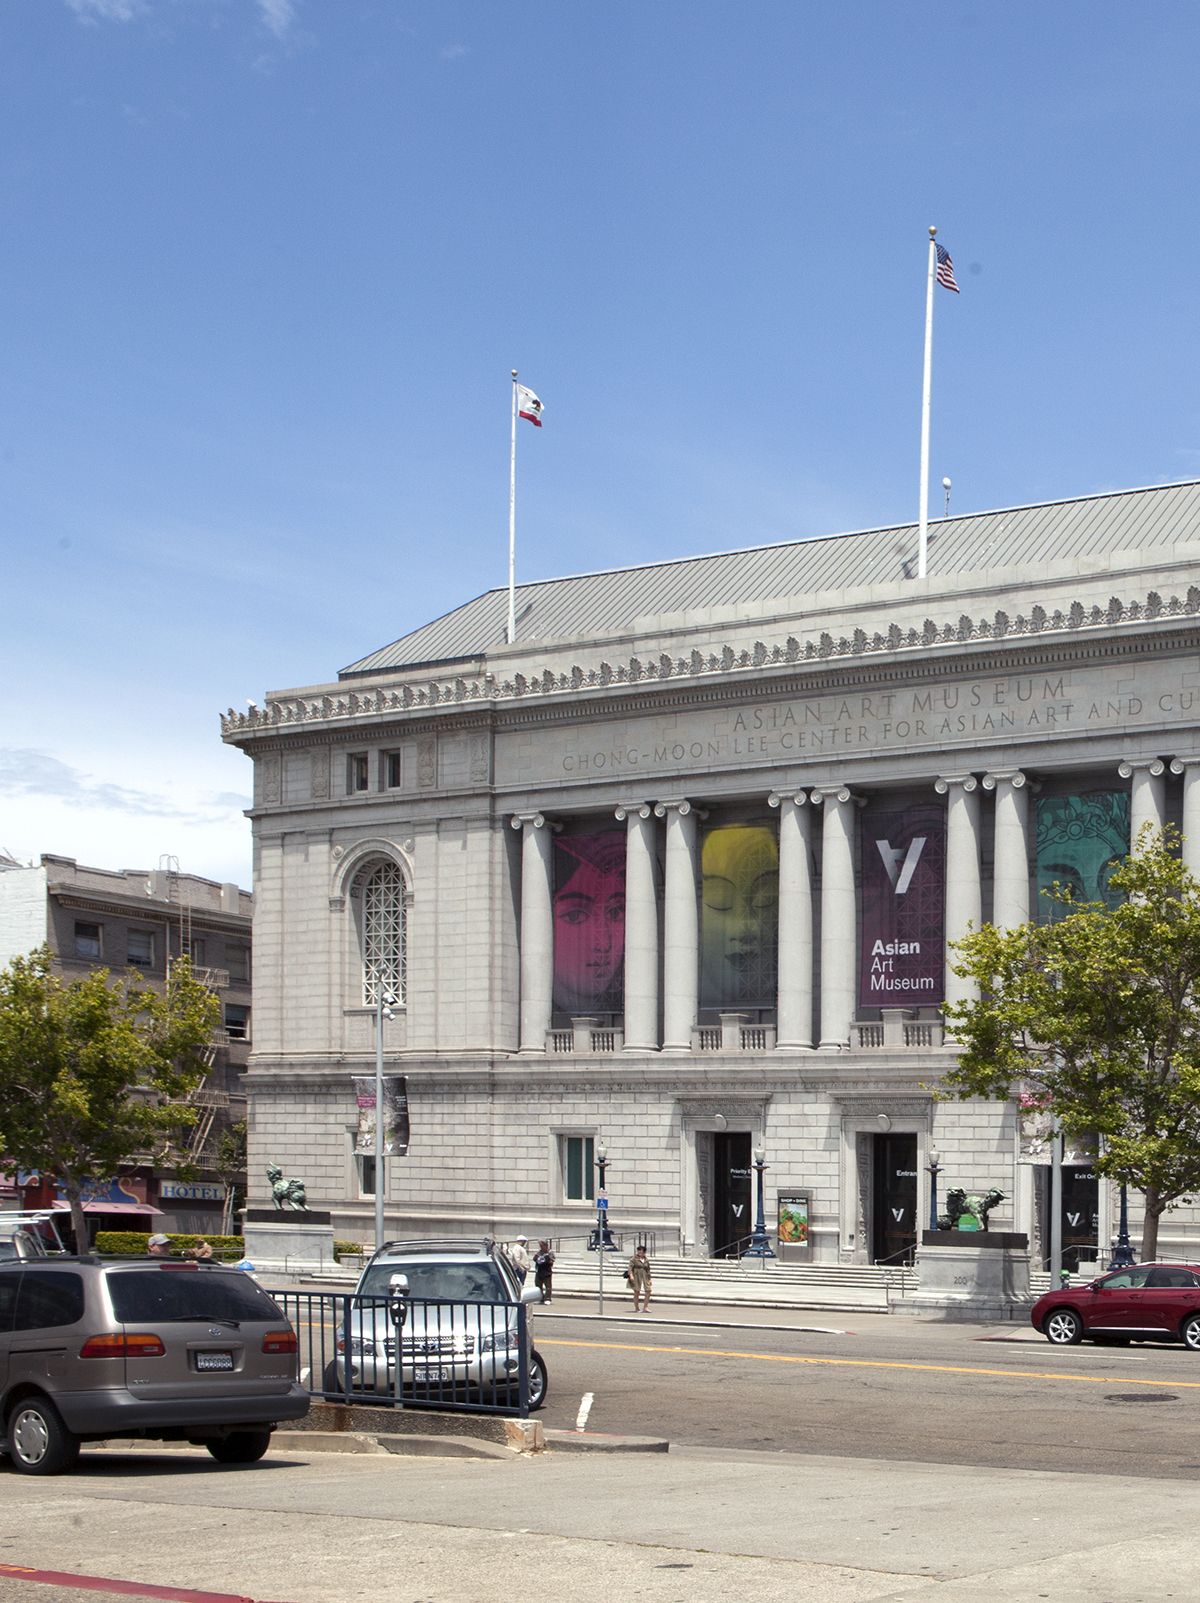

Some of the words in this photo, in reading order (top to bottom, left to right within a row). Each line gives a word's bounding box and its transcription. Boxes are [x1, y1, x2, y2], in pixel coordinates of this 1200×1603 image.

[732, 702, 824, 733] ASIAN
[836, 695, 896, 721] ART
[911, 677, 1066, 715] MUSEUM
[562, 740, 721, 771] CHONG-MOON
[733, 736, 768, 754] LEE
[780, 725, 869, 749] CENTER
[882, 720, 928, 739] FOR
[939, 710, 1015, 735] ASIAN
[1027, 704, 1075, 726] ART
[1088, 698, 1143, 719] AND
[871, 939, 920, 956] Asian
[870, 956, 893, 973] Art
[870, 974, 934, 991] Museum
[896, 1169, 917, 1177] Entran
[163, 1186, 224, 1200] HOTEL
[954, 1277, 967, 1285] 200
